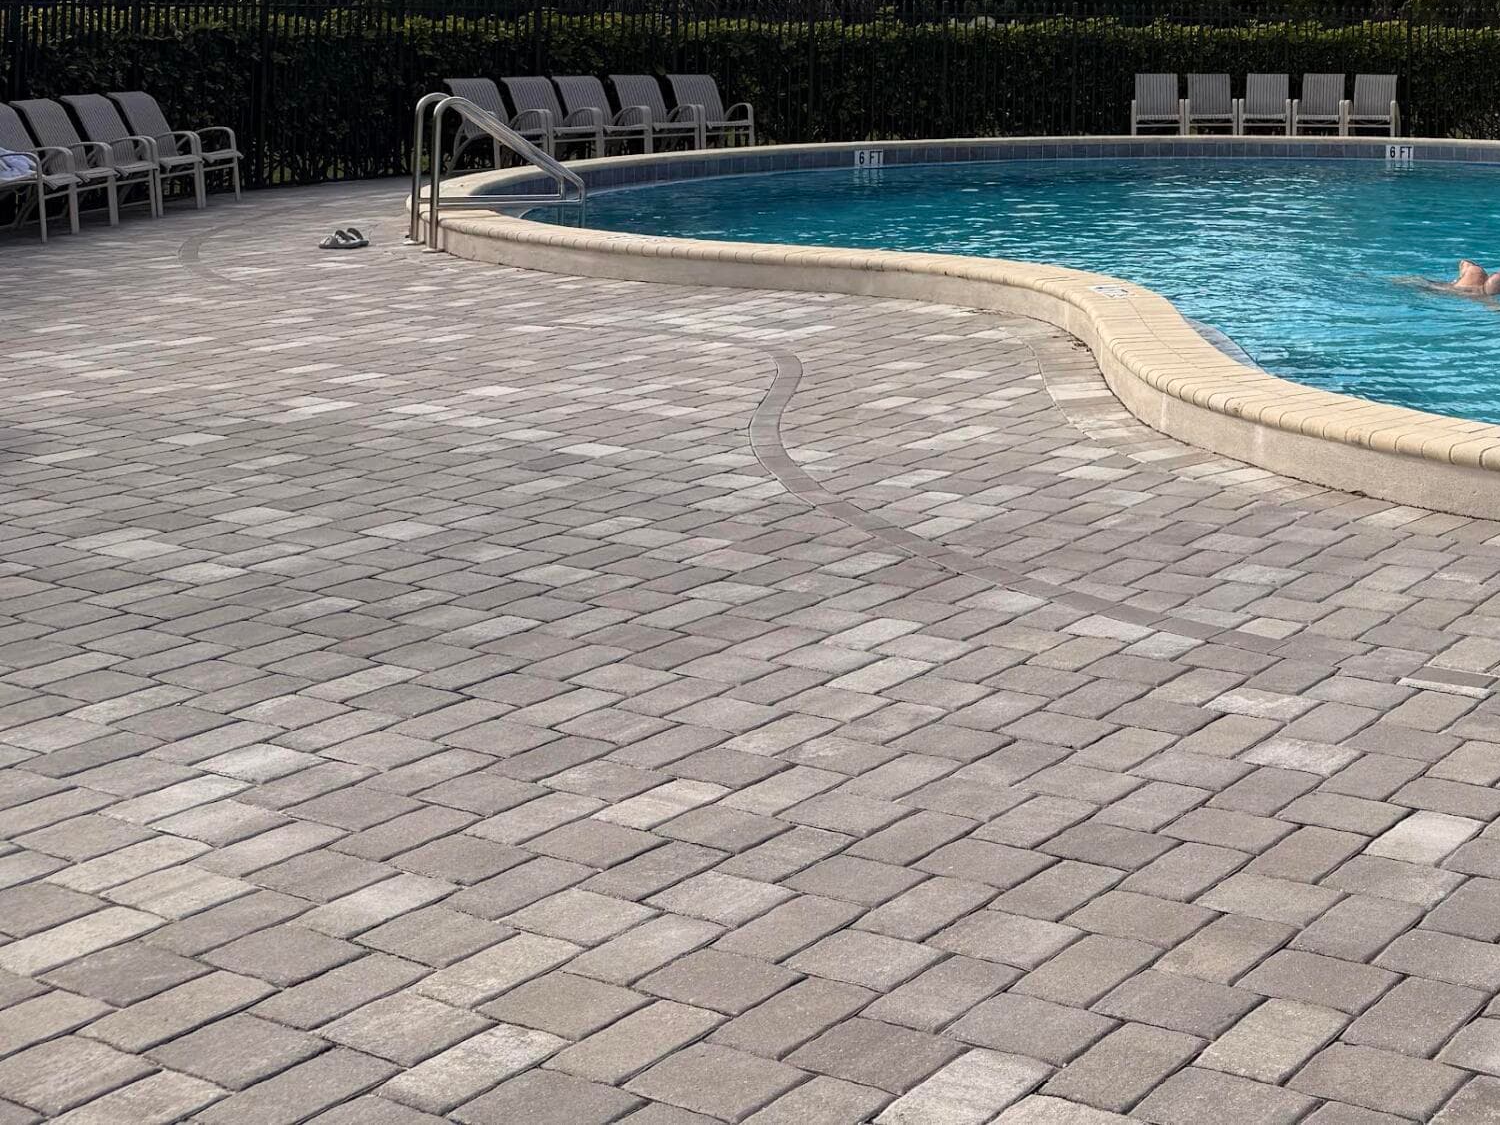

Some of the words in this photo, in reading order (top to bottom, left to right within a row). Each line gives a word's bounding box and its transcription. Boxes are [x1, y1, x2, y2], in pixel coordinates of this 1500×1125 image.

[859, 151, 864, 164] 6
[869, 151, 882, 164] FT
[1390, 146, 1395, 158] 6
[1400, 146, 1412, 158] FT
